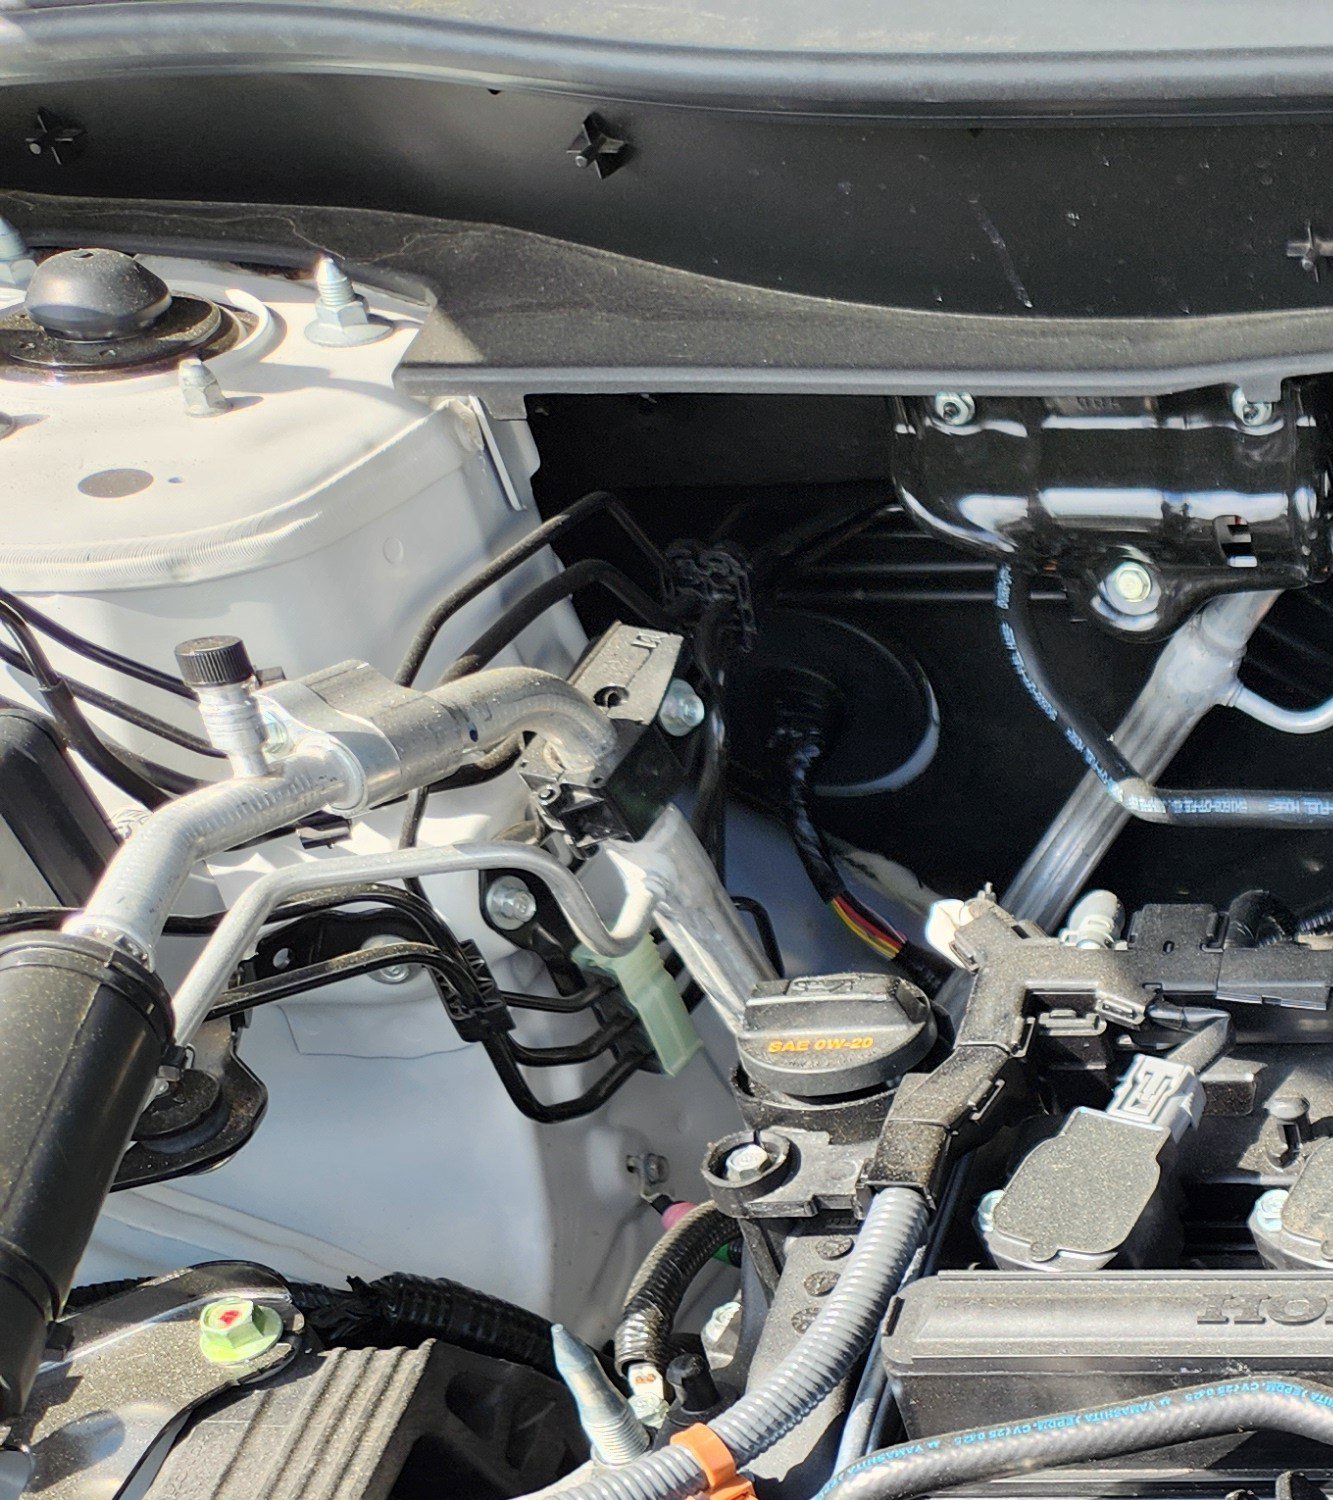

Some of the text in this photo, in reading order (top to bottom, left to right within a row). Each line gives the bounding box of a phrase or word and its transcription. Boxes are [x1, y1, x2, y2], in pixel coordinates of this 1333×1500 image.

[768, 1036, 874, 1053] SAE 0W-20
[1083, 1401, 1157, 1424] YAMASHITA
